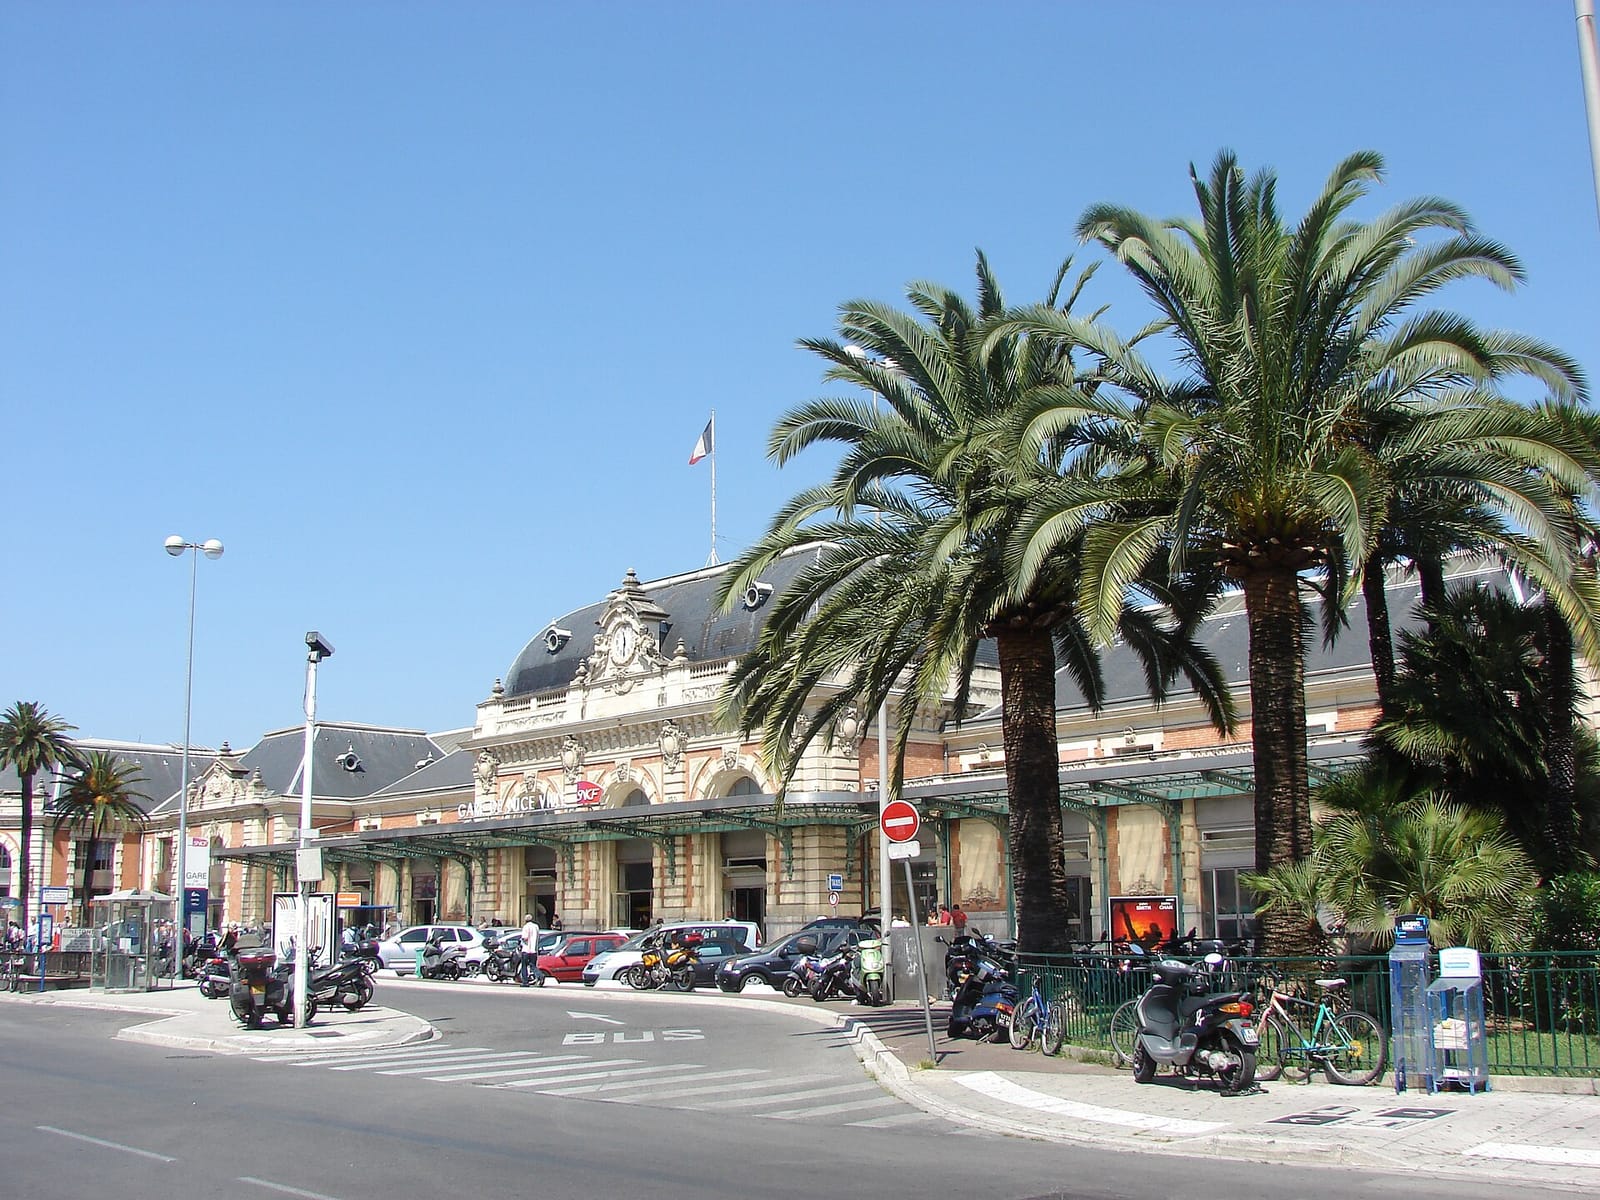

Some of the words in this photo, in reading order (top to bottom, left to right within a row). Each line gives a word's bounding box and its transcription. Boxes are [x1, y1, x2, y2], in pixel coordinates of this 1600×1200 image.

[577, 788, 600, 800] SNCF
[457, 801, 485, 818] GARE
[507, 795, 536, 812] NICE
[185, 871, 207, 880] GARE
[562, 1029, 705, 1045] BUS
